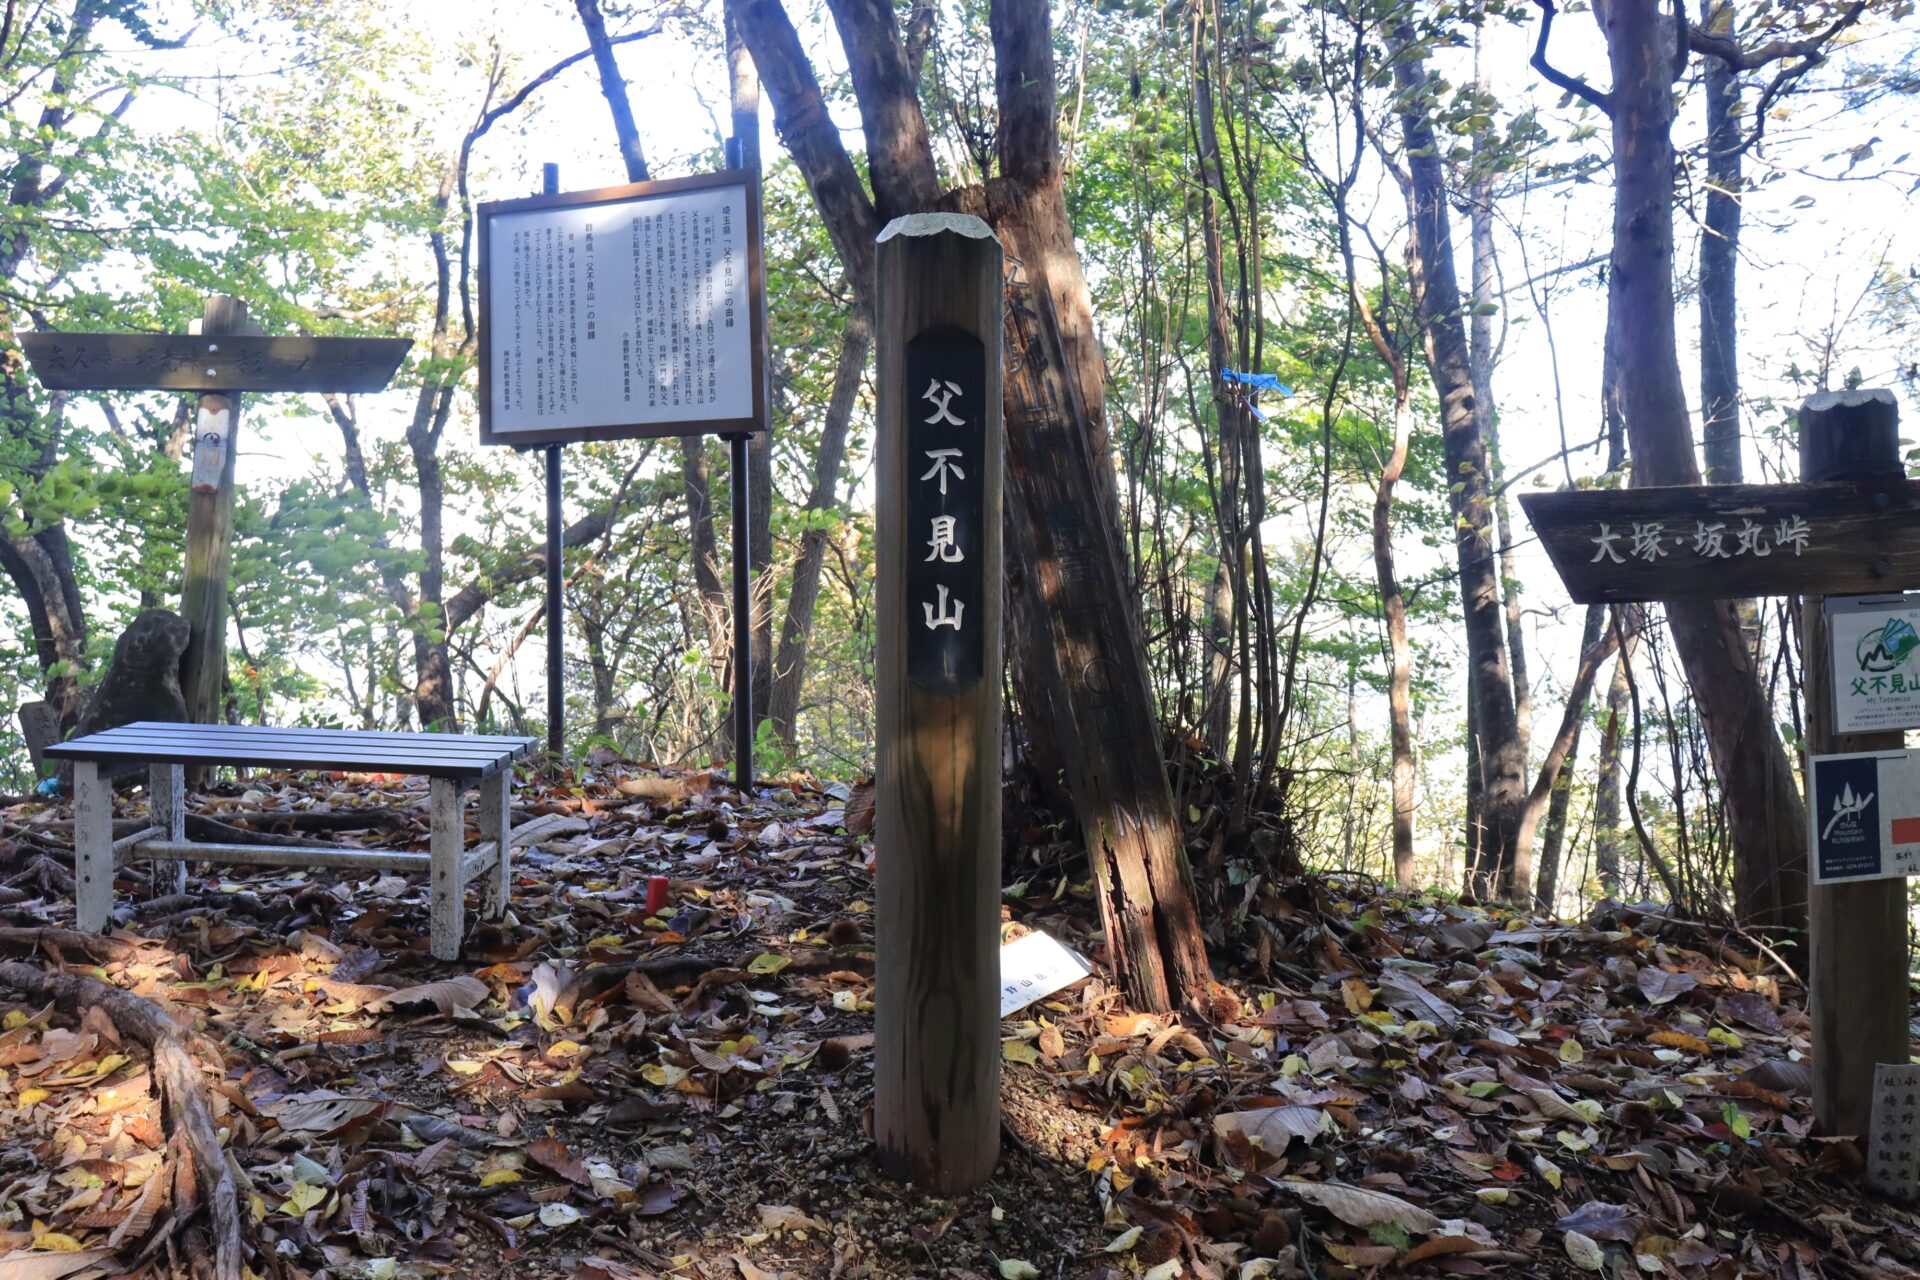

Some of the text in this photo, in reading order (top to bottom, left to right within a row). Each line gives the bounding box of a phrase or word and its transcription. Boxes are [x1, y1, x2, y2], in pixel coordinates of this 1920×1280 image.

[919, 377, 967, 632] 父不見山
[1589, 513, 1812, 566] 大塚・坂丸峠
[1850, 673, 1920, 697] 父不見山
[1833, 828, 1864, 836] Mountain
